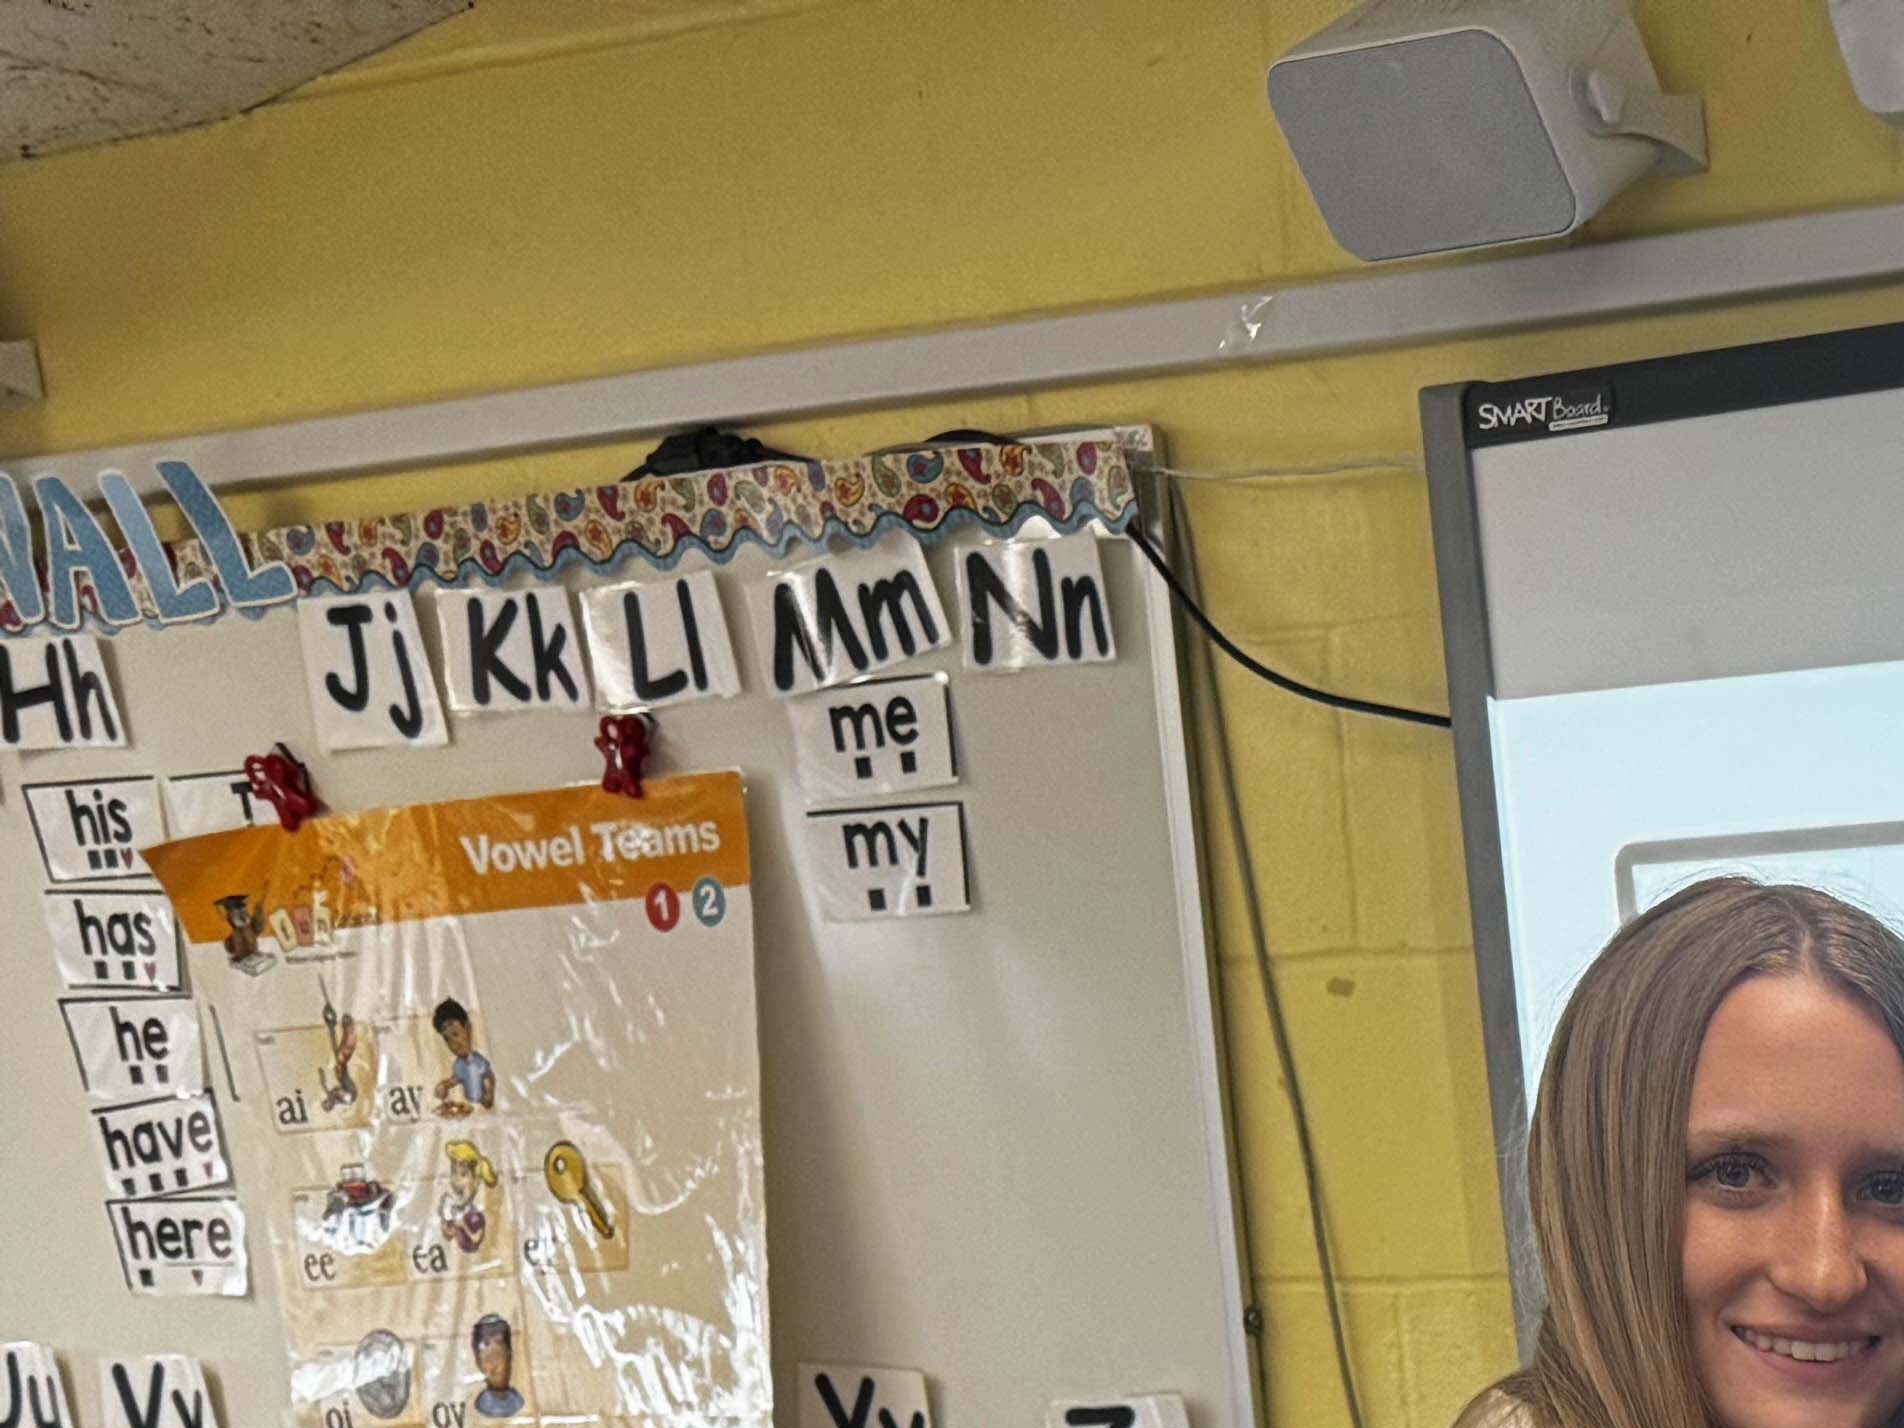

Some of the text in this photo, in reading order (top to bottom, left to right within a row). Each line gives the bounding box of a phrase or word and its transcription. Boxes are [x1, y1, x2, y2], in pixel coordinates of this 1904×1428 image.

[1479, 397, 1552, 430] SMART
[773, 568, 939, 691] Mm
[966, 547, 1109, 665] Nn
[467, 591, 579, 706] Kk
[623, 579, 708, 701] Ll
[0, 637, 118, 743] Hh
[325, 602, 424, 739] Jj
[829, 695, 918, 753] me
[66, 787, 132, 846] his
[459, 820, 721, 875] Vowel Teams
[842, 816, 929, 878] my
[74, 899, 156, 957] has
[655, 884, 719, 922] 1 2
[109, 1006, 168, 1062] he
[276, 1084, 423, 1126] ai ay
[99, 1110, 213, 1170] have
[121, 1205, 232, 1261] here
[304, 1249, 337, 1282] ee
[412, 1236, 448, 1273] ea
